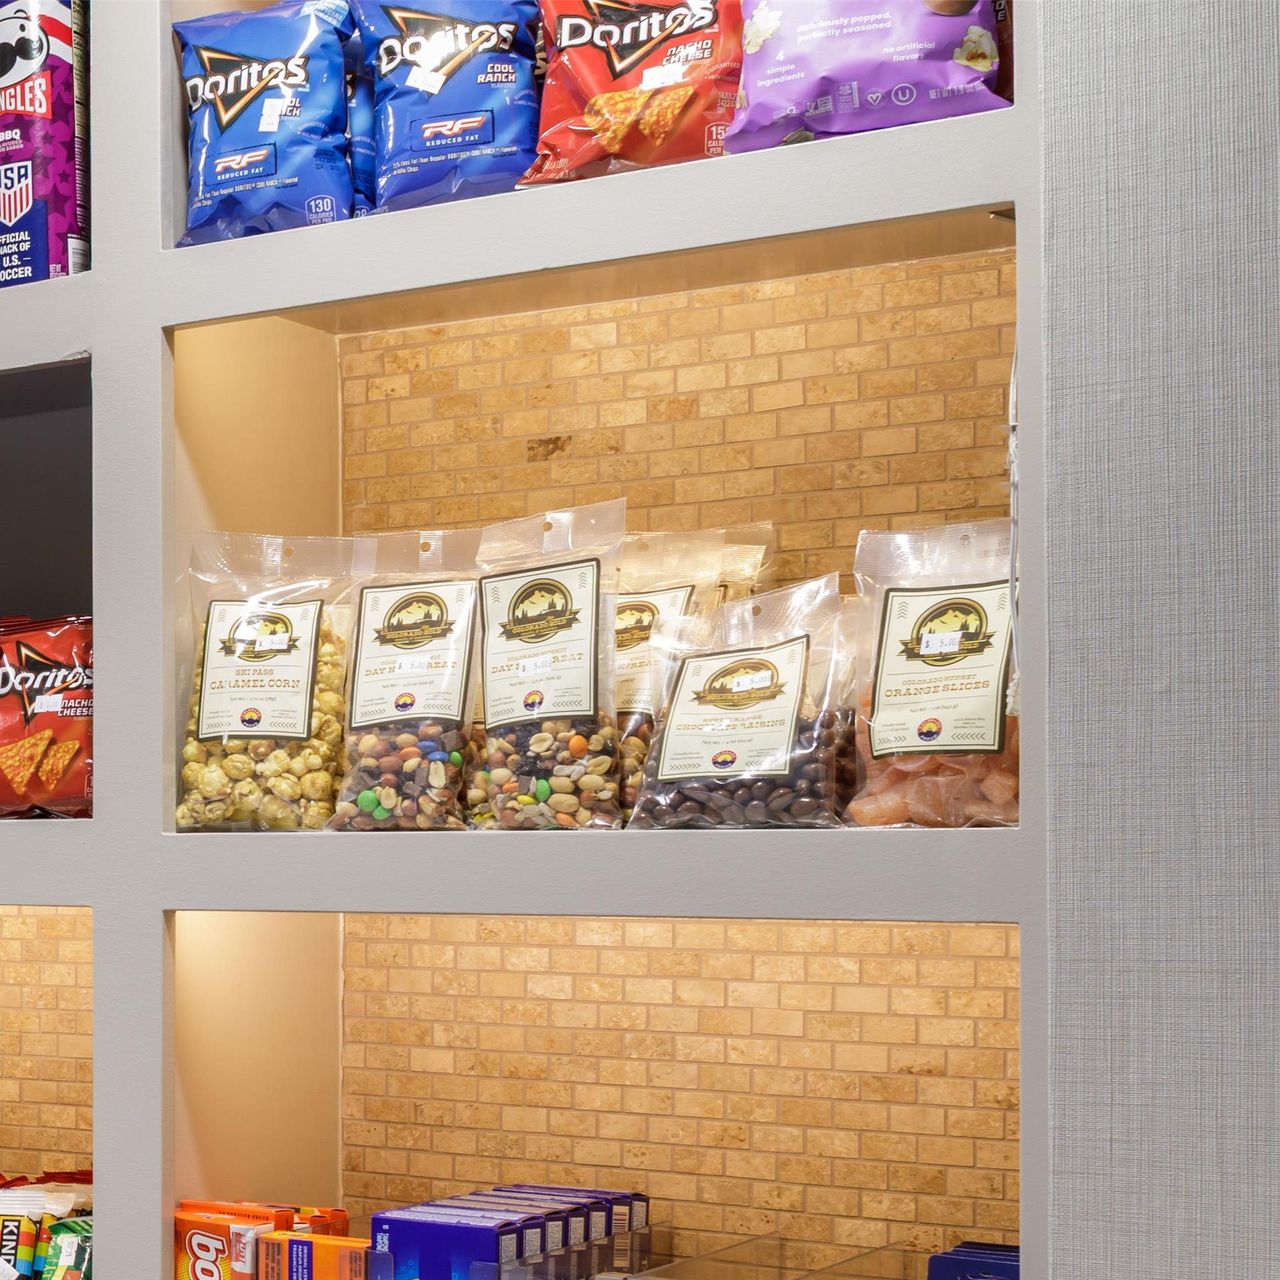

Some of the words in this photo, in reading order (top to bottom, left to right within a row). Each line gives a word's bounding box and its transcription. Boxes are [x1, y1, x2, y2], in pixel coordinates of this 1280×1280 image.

[559, 0, 717, 48] Doritos
[845, 21, 892, 33] seasoned
[379, 23, 518, 74] Doritos
[487, 64, 514, 73] COOL
[766, 63, 795, 76] simple
[187, 56, 309, 110] Doritos
[477, 73, 516, 84] RANCH
[757, 71, 805, 87] ingredients
[426, 137, 461, 147] REDUCED
[465, 134, 479, 143] FAT
[309, 199, 331, 213] 130
[19, 242, 30, 251] OF
[3, 255, 21, 266] U.S.
[885, 685, 939, 697] ORANGE
[941, 680, 990, 691] SLICES
